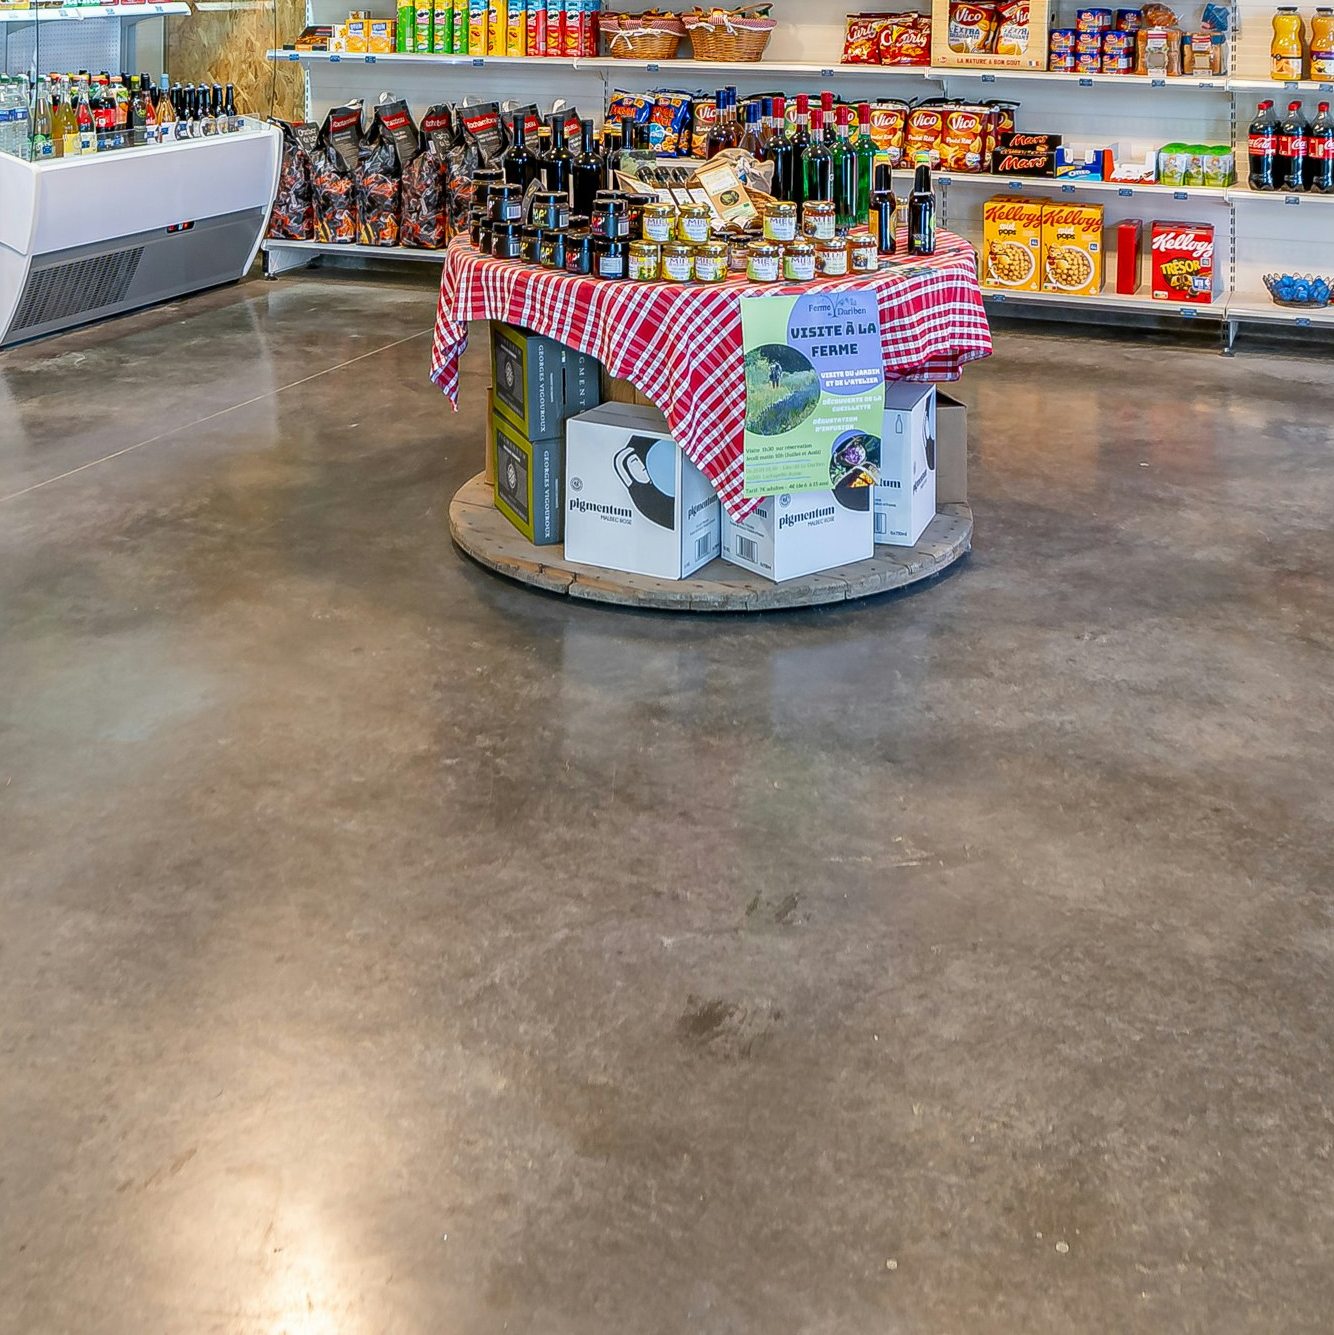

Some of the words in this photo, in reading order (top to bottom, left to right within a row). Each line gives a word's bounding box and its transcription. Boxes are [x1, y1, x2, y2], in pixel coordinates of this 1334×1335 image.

[955, 7, 983, 23] Vico
[848, 25, 876, 42] Curly
[965, 57, 987, 65] NATURE
[872, 115, 897, 128] Vico
[912, 114, 938, 128] Vico
[950, 116, 977, 130] Vico
[1009, 134, 1048, 146] Mars
[998, 155, 1048, 171] Mars
[809, 304, 831, 313] Ferme
[837, 306, 866, 316] Dariben
[790, 324, 843, 339] VISITE
[845, 320, 855, 335] À
[858, 322, 877, 335] LA
[811, 343, 859, 358] FERME
[820, 371, 844, 379] VISITE
[855, 368, 881, 377] JARDIN
[834, 379, 843, 387] DE
[539, 382, 547, 433] VIGOUROUX
[569, 498, 632, 518] pigmentum
[778, 505, 835, 530] pigmentum
